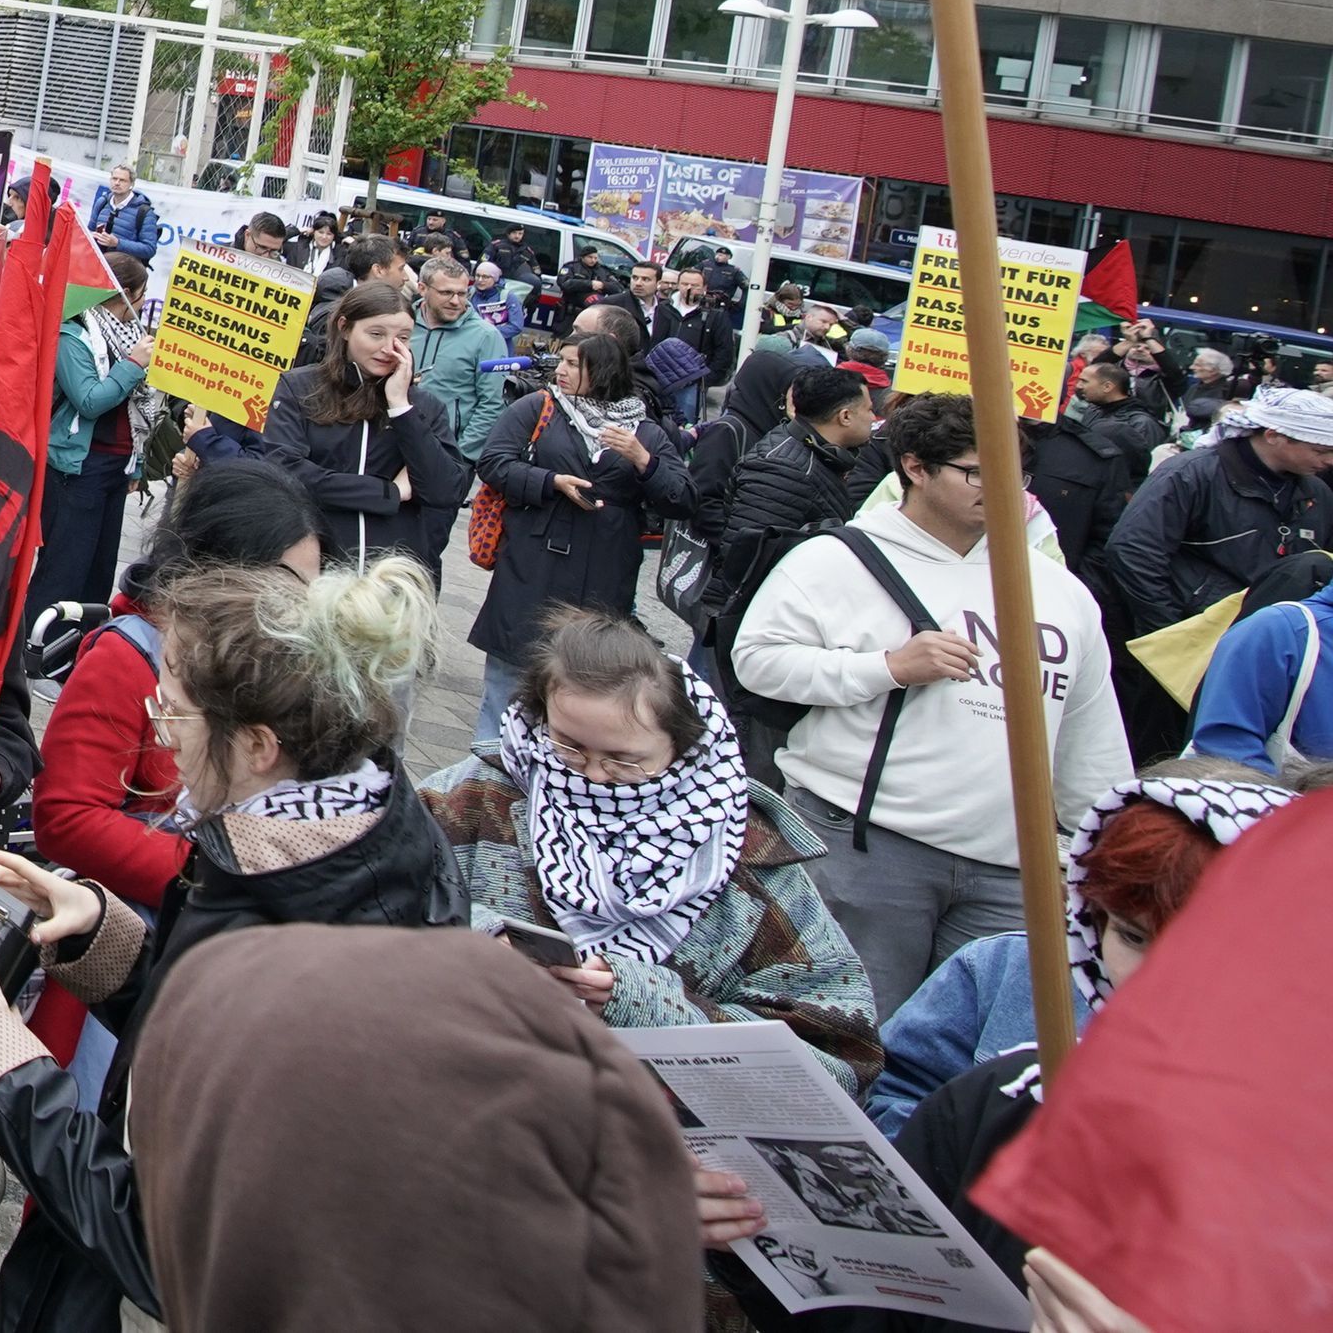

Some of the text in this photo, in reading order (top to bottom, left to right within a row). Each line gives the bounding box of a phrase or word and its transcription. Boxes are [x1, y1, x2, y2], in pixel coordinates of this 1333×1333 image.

[599, 166, 635, 175] TÄGLICH
[607, 175, 638, 185] 16:00
[664, 161, 742, 185] TASTE OF
[178, 256, 301, 311] FREIHEIT FÜR
[918, 271, 1059, 306] PALINA!
[921, 253, 1072, 289] FREIT FÜR
[173, 274, 289, 326] PALÄSTINA!
[916, 296, 1041, 328] RASSUS
[169, 297, 271, 344] RASSISMUS
[158, 339, 265, 390] Islamophobie
[907, 340, 1041, 376] Islamobie
[154, 355, 242, 400] bekämpfen
[958, 697, 988, 710] COLOR
[972, 709, 988, 718] THE
